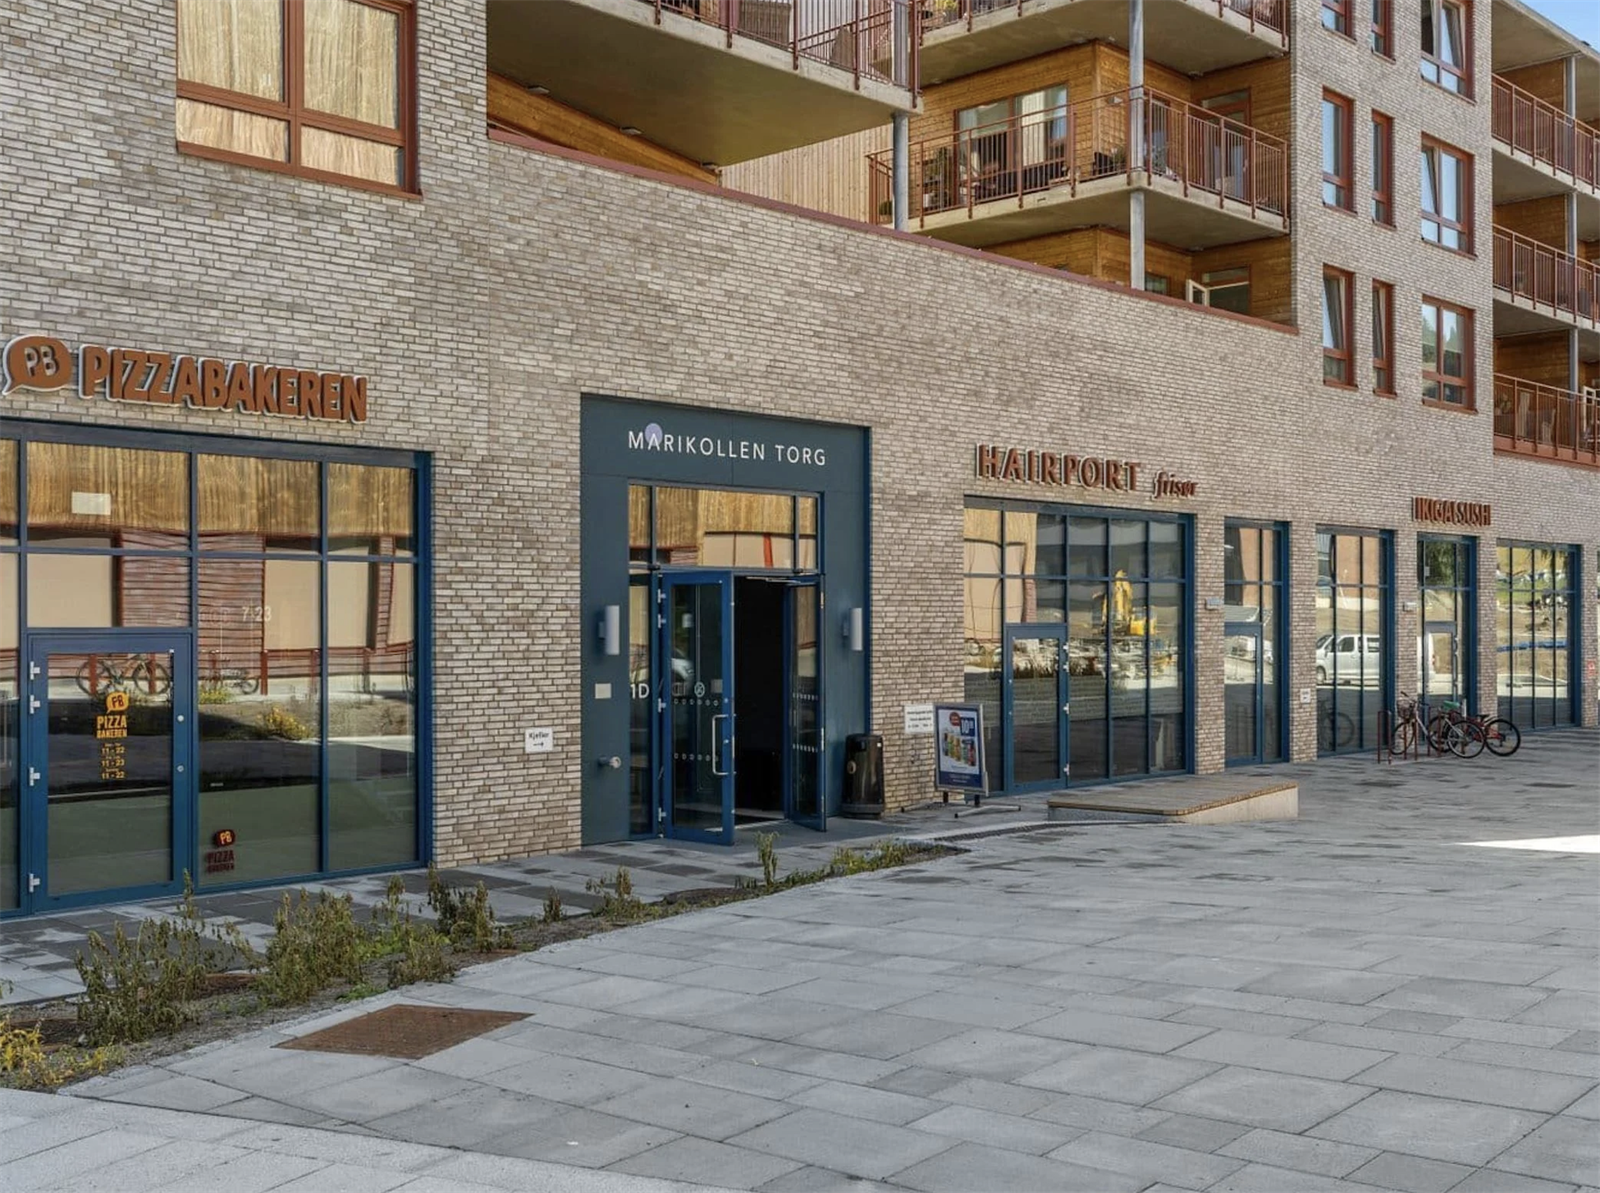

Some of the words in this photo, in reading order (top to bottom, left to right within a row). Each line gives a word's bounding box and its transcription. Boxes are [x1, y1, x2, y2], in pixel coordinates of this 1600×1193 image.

[25, 345, 59, 378] PB
[79, 344, 367, 423] PIZZABAKEREN
[628, 430, 765, 460] MARIKOLLEN
[774, 444, 826, 466] TORG
[976, 443, 1141, 492] HAIRPORT
[97, 716, 127, 729] PIZZA
